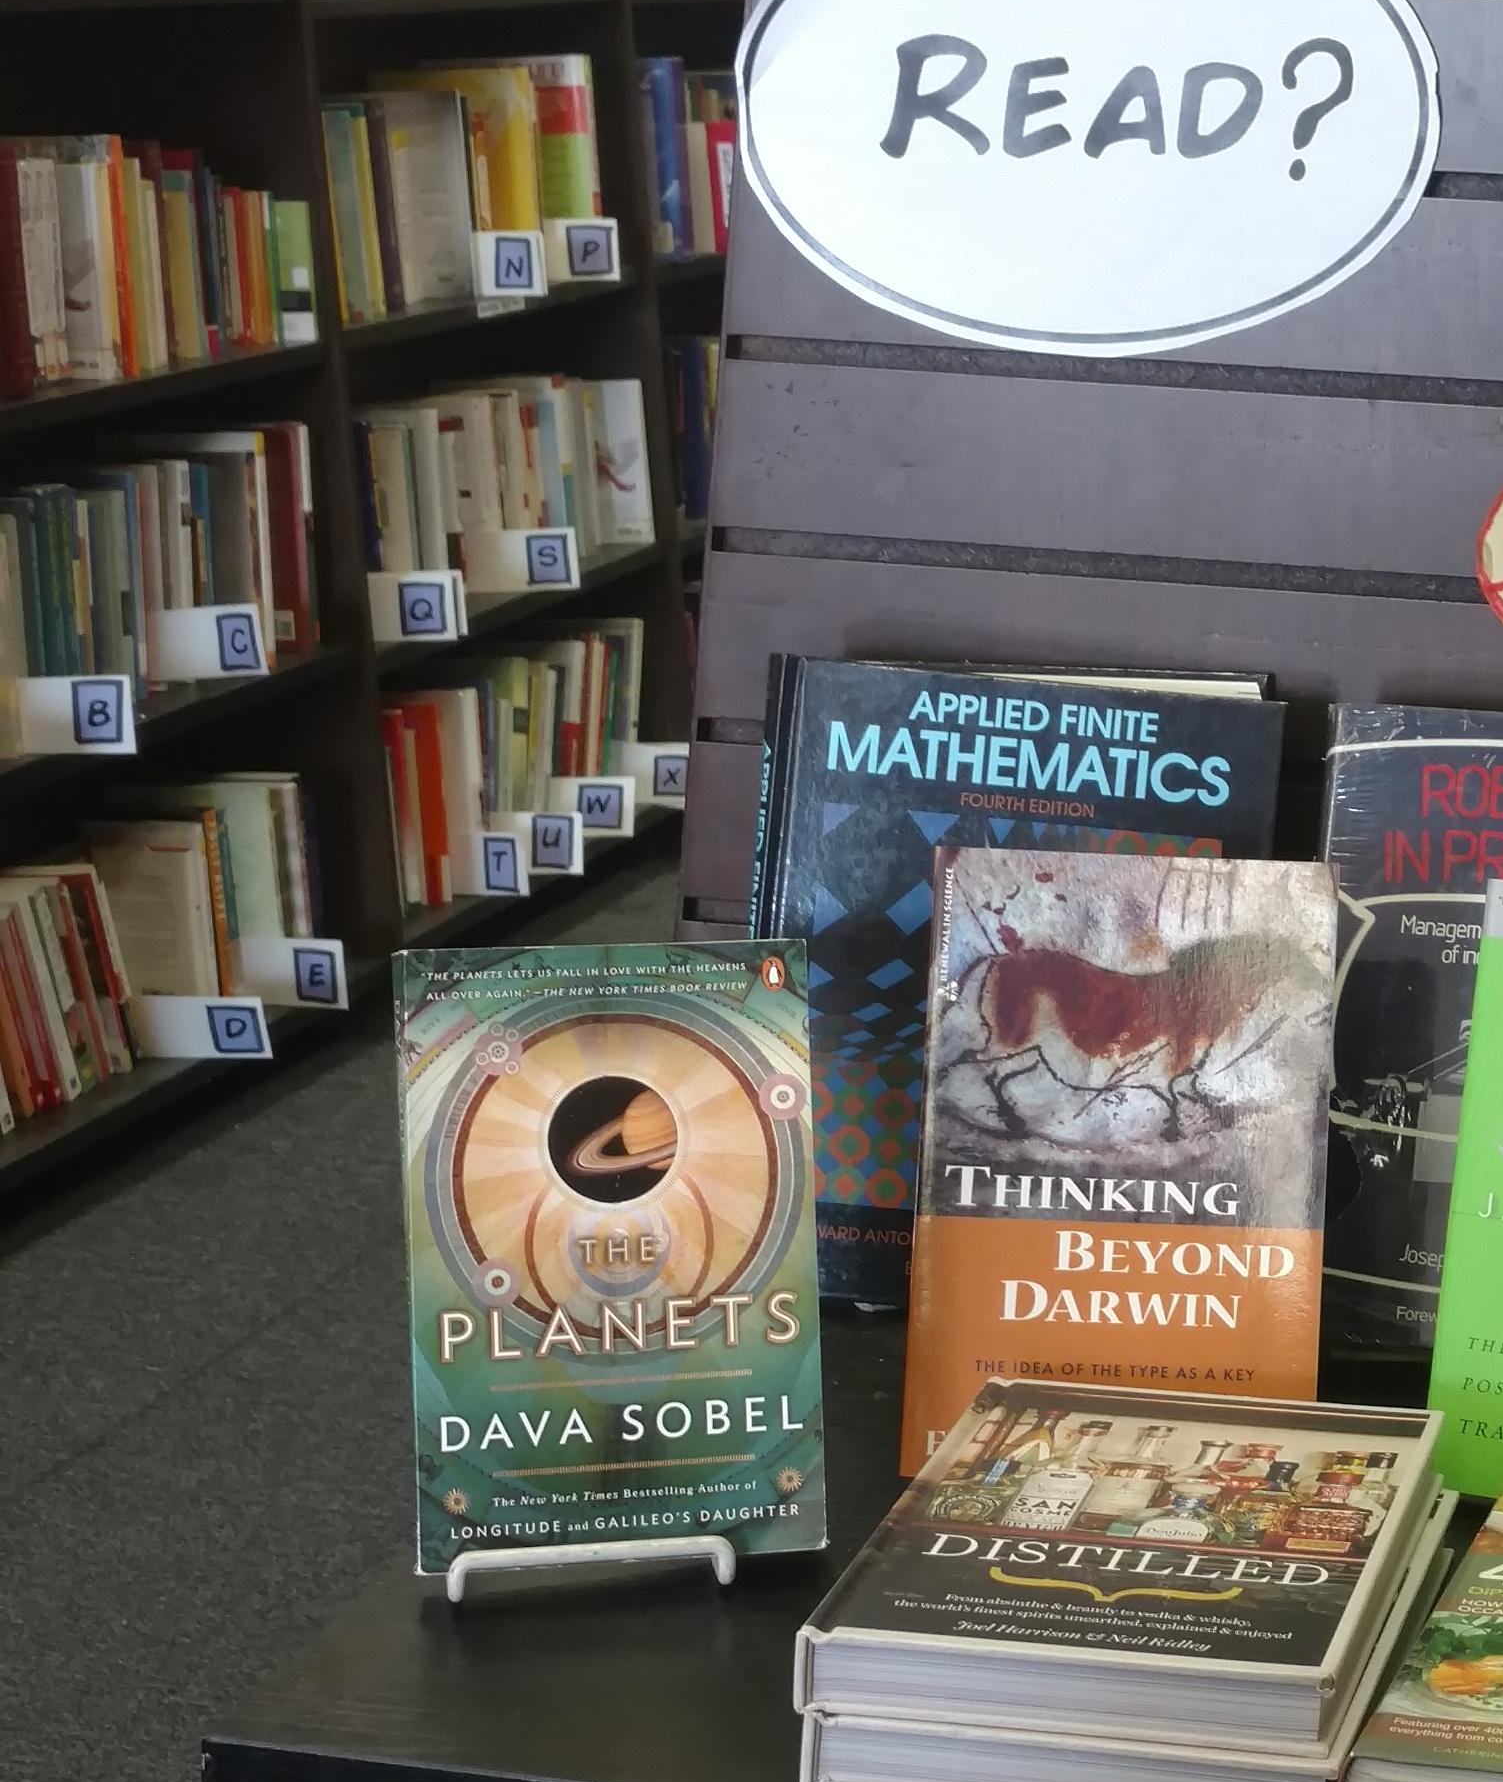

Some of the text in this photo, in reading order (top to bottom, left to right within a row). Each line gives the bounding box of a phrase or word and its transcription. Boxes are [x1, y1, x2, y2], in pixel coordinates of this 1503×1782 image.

[879, 33, 1354, 181] READ?
[909, 690, 1159, 743] APPLIED FINITE
[827, 721, 1231, 807] MATHEMATICS
[960, 791, 1095, 819] FOURTH EDITION
[1384, 830, 1430, 884] IN
[945, 1165, 1241, 1216] THINKING
[578, 1236, 659, 1265] THE
[1055, 1230, 1295, 1279] BEYOND
[438, 1290, 800, 1364] PLANETS
[1000, 1280, 1241, 1330] DARWIN
[975, 1360, 1256, 1382] THE IDEA OF THE TYPE AS A KEY
[440, 1394, 803, 1453] DAVA SOBEL
[493, 1479, 757, 1508] The New York Times Bestselling Author of
[450, 1504, 799, 1540] LONGITUDE and GALILEO'S DAUGHTER
[920, 1532, 1329, 1586] DISTILLED
[953, 1620, 993, 1631] Joel
[995, 1623, 1081, 1640] Harrison
[1106, 1633, 1148, 1645] Neil
[1150, 1637, 1212, 1653] Ridley
